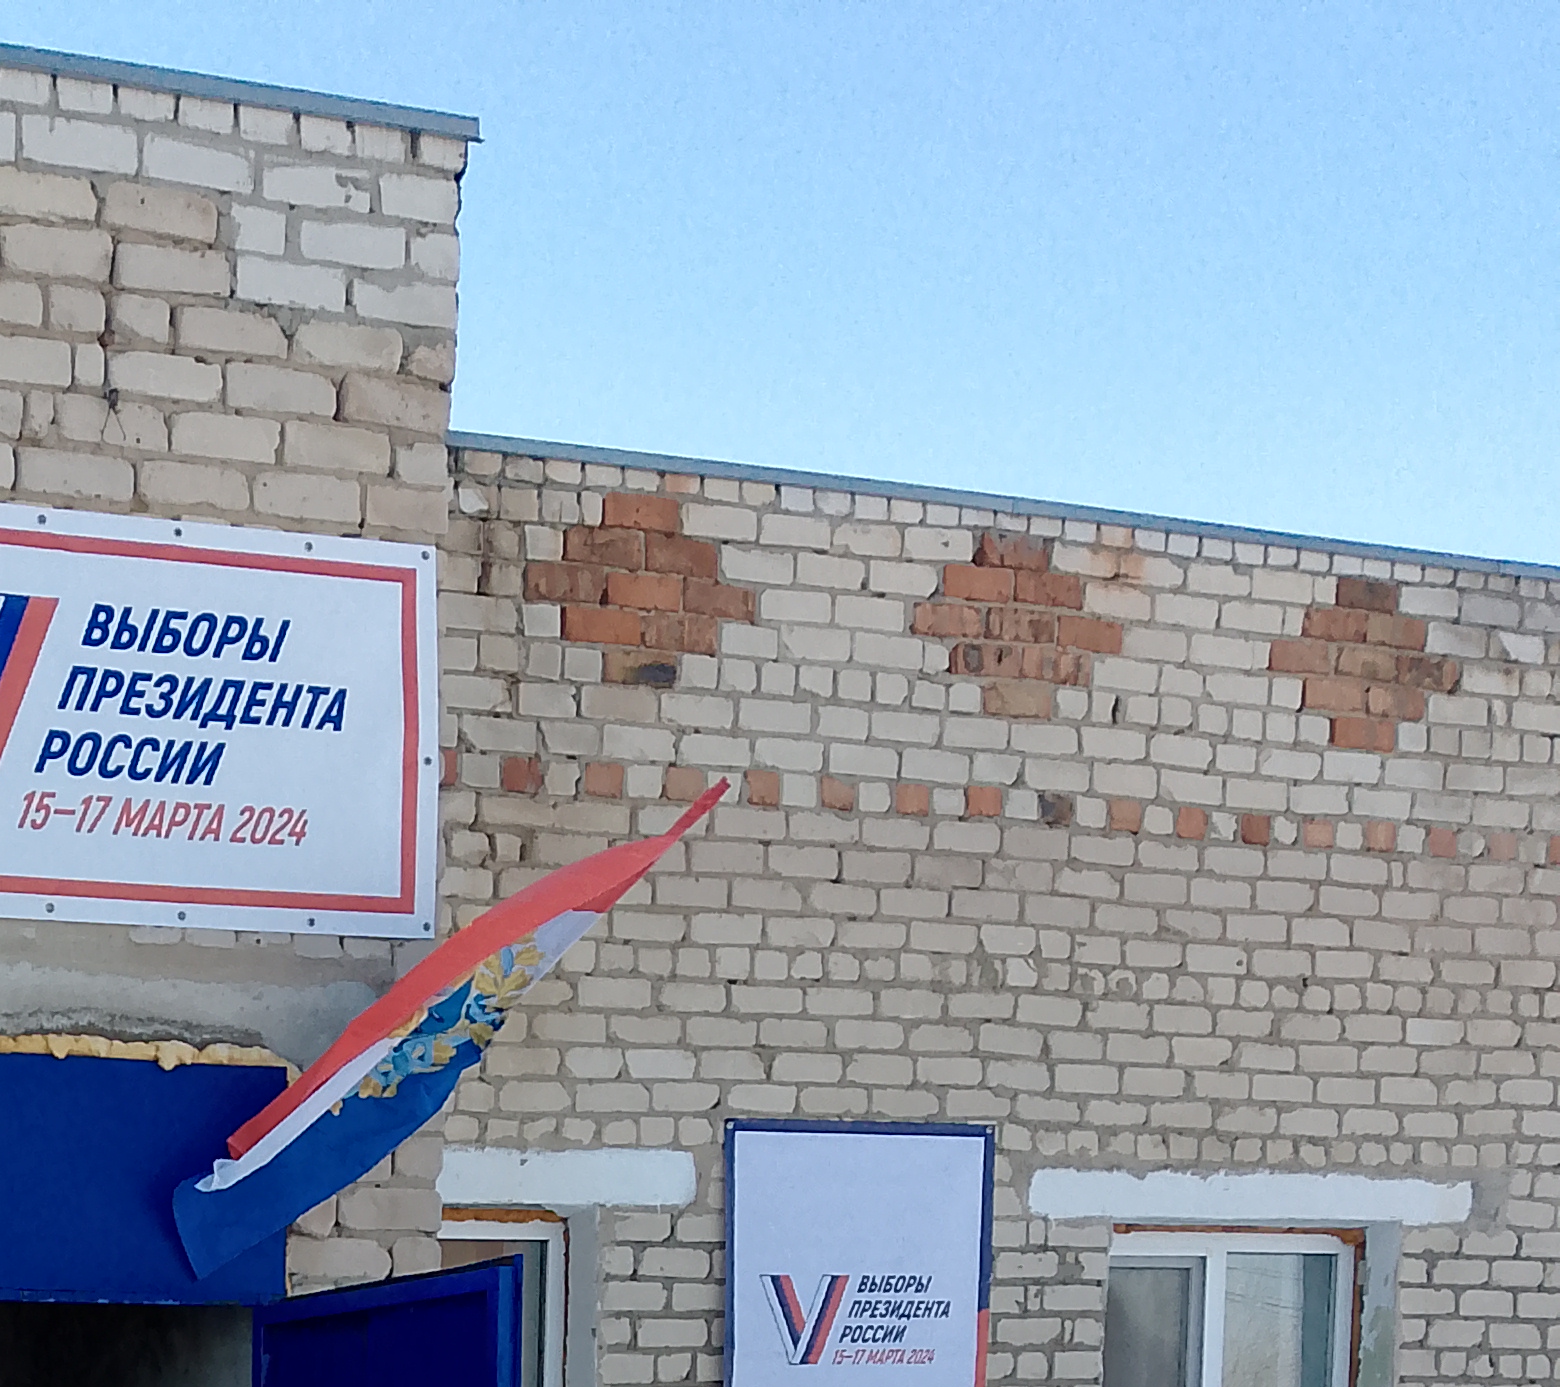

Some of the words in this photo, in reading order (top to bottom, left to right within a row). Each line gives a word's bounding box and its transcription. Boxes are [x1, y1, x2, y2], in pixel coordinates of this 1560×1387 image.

[81, 603, 291, 664] ВЫБОРЫ
[57, 665, 348, 733] ПРЕЗИДЕНТА
[34, 729, 227, 787] РОССИИ
[113, 797, 224, 843] МАРТА
[229, 805, 309, 847] 2024
[857, 1274, 933, 1294] ВЫБОРЫ
[847, 1299, 951, 1321] ПРЕЗИДЕНТА
[838, 1324, 907, 1344] РОССИИ
[866, 1348, 906, 1365] МАРТА
[907, 1348, 936, 1365] 2024
